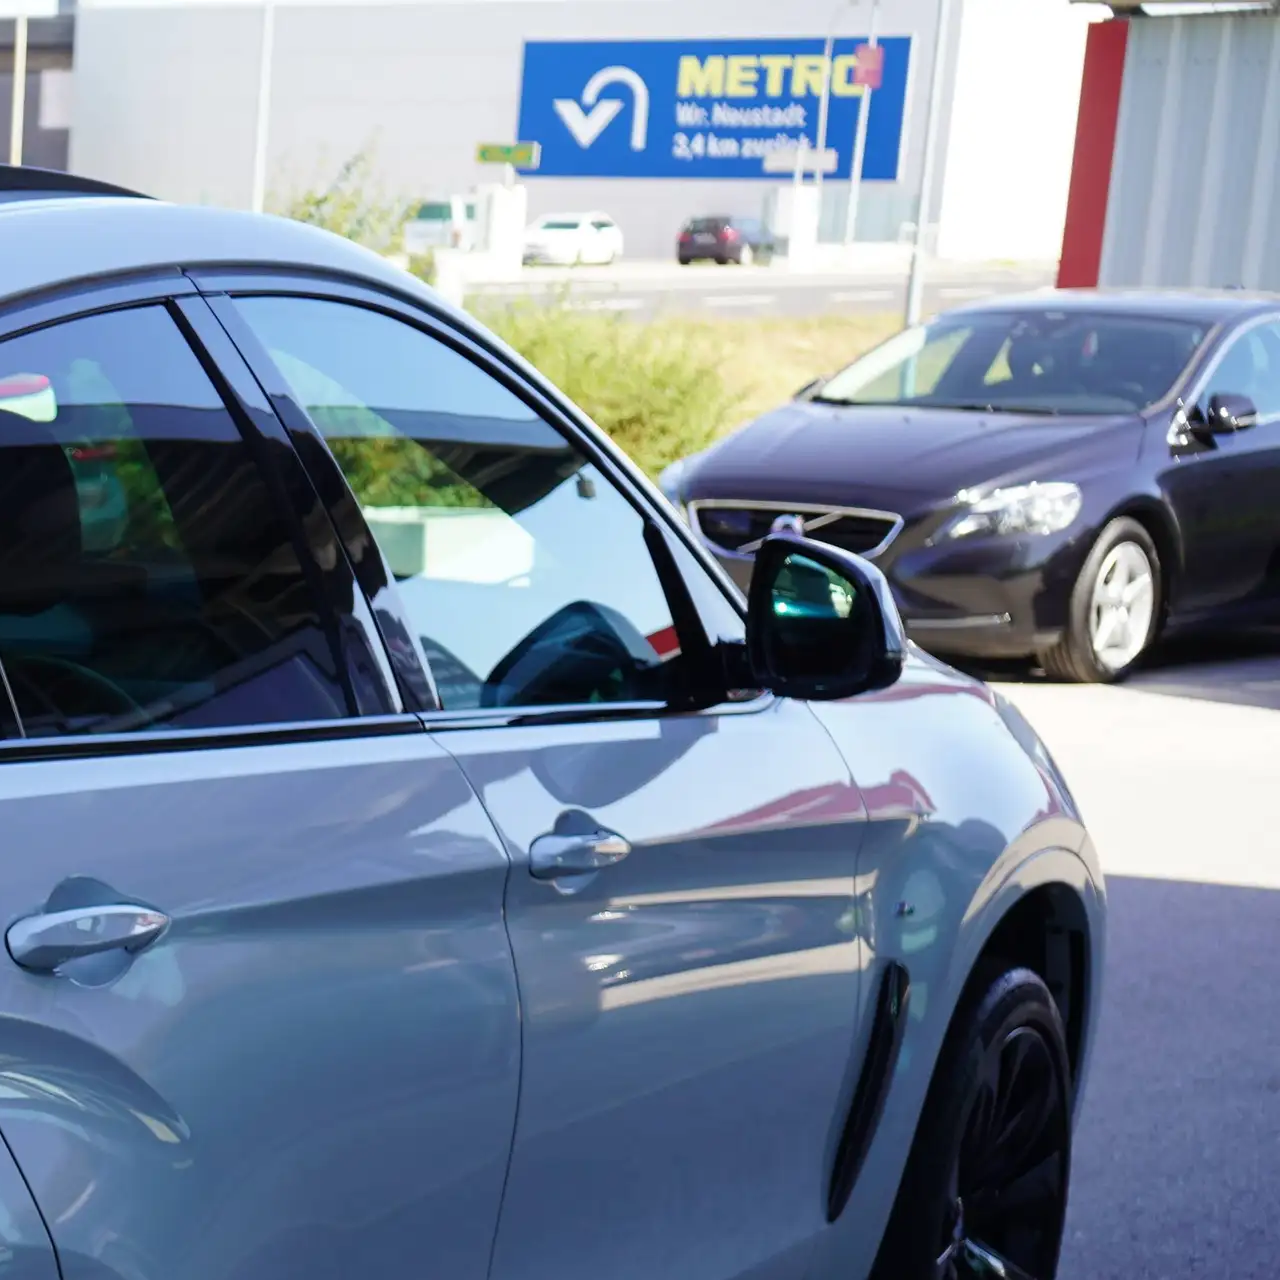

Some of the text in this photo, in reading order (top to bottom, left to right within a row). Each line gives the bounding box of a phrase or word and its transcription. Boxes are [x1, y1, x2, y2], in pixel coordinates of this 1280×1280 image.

[675, 101, 807, 128] Wr. Neustadt
[707, 132, 740, 158] km
